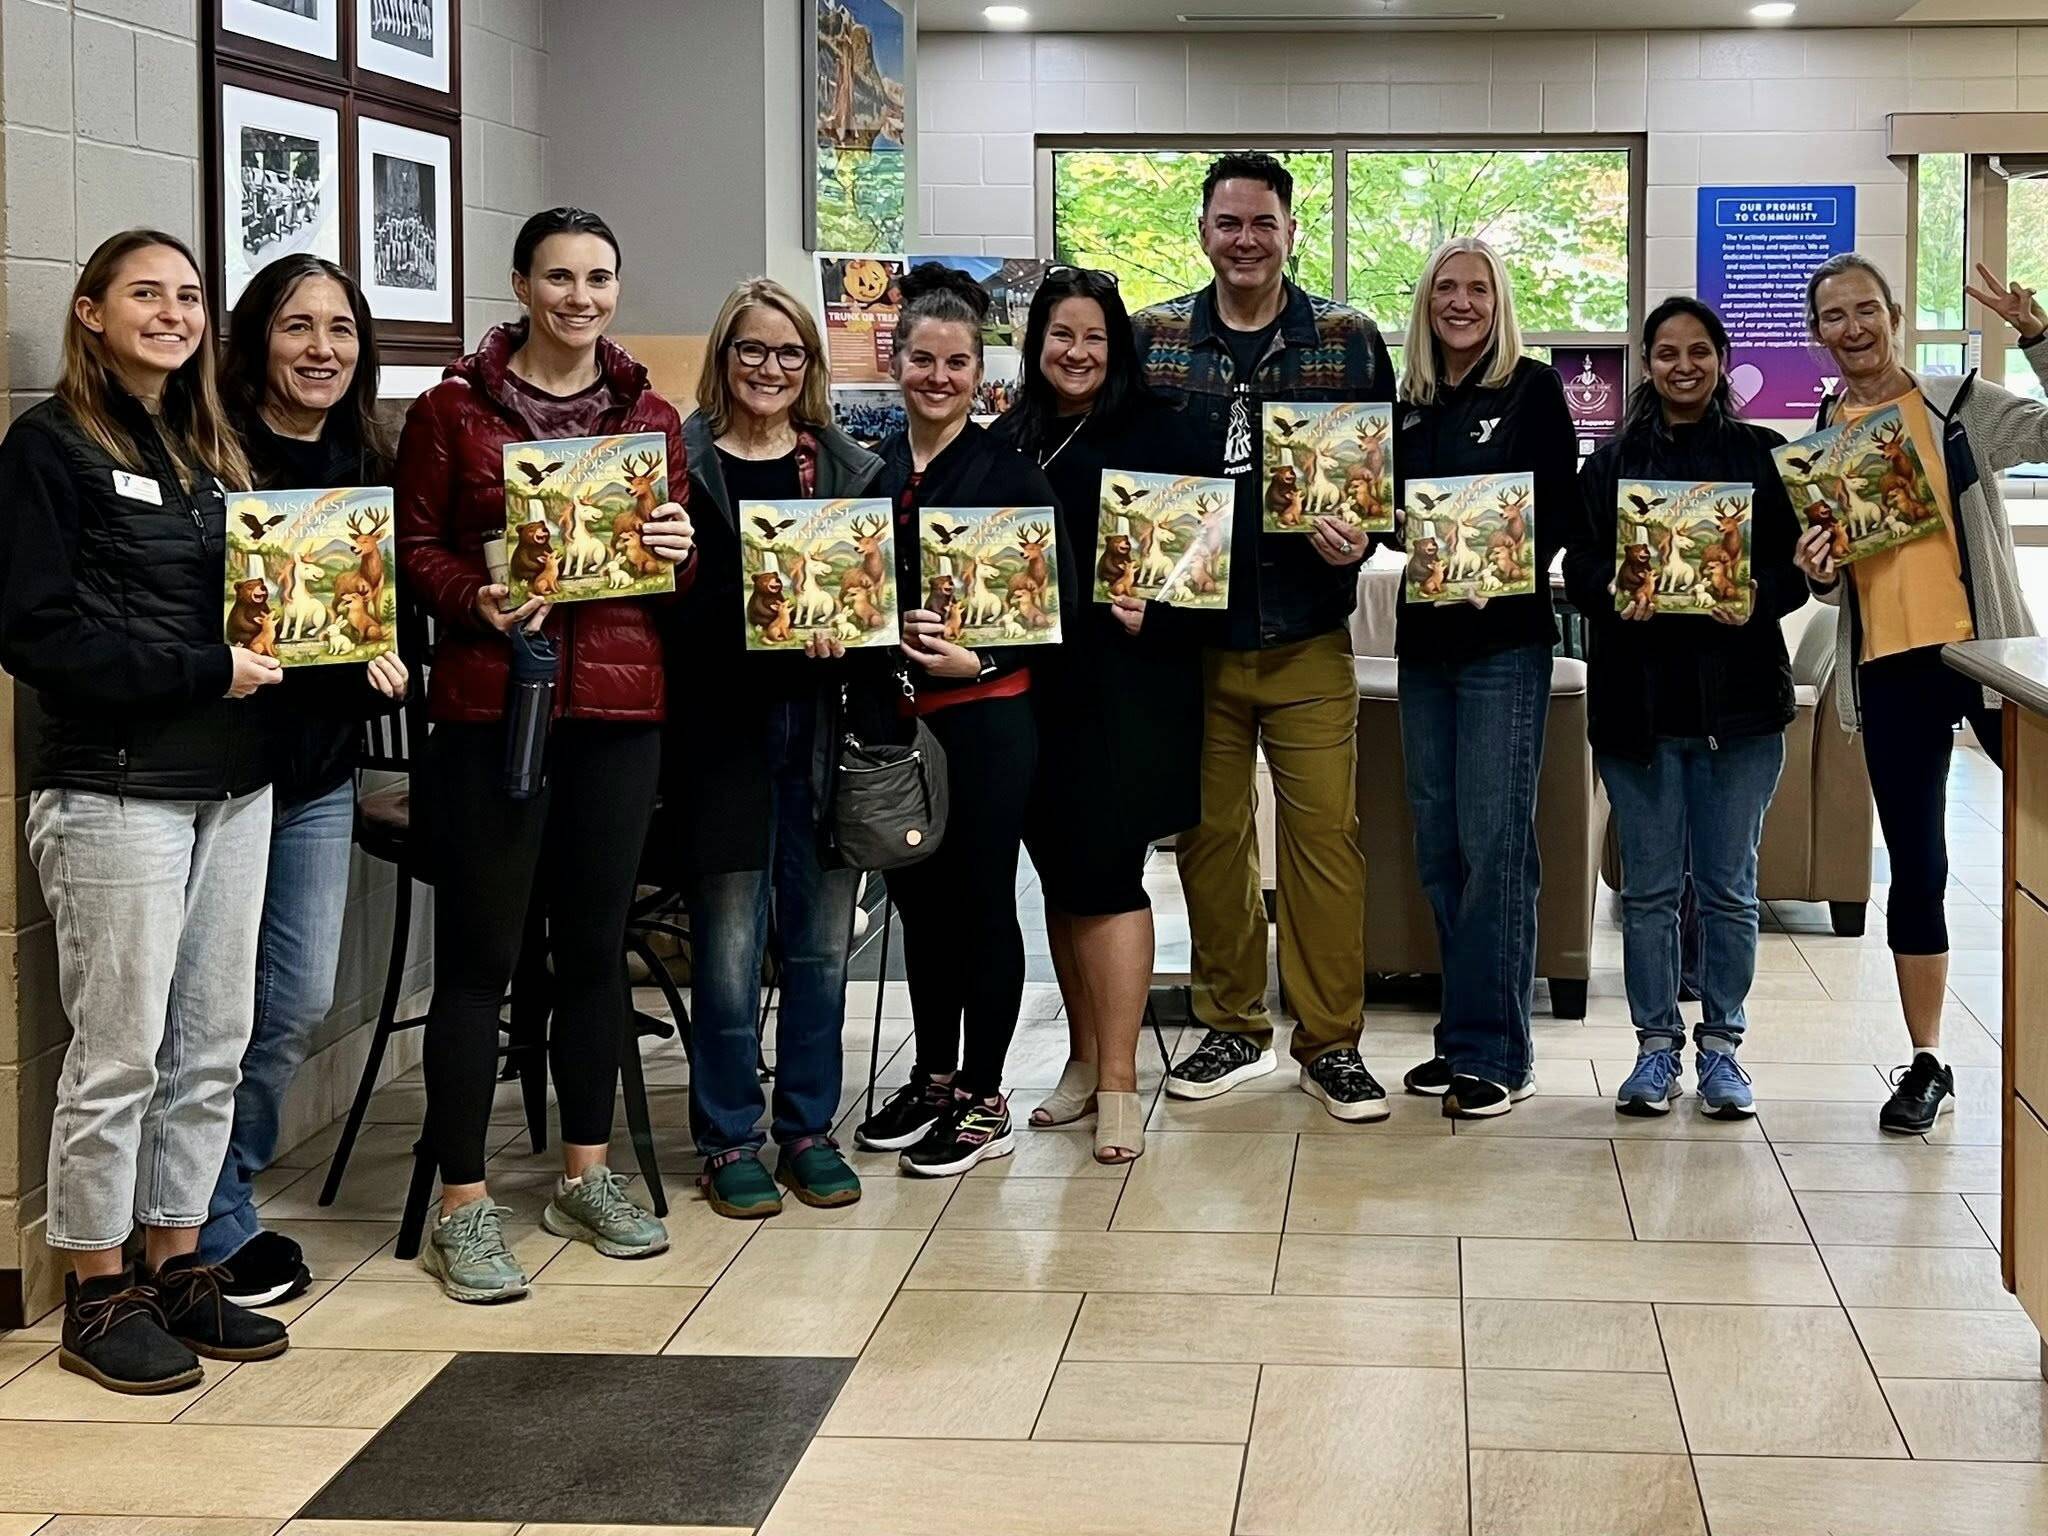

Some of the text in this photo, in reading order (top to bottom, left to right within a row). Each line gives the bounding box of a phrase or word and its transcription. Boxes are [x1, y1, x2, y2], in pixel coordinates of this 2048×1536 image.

[1740, 202, 1813, 211] OUR PROMISE
[1735, 213, 1818, 222] TO COMMUNITY
[828, 311, 899, 322] TRUNK OR TREA
